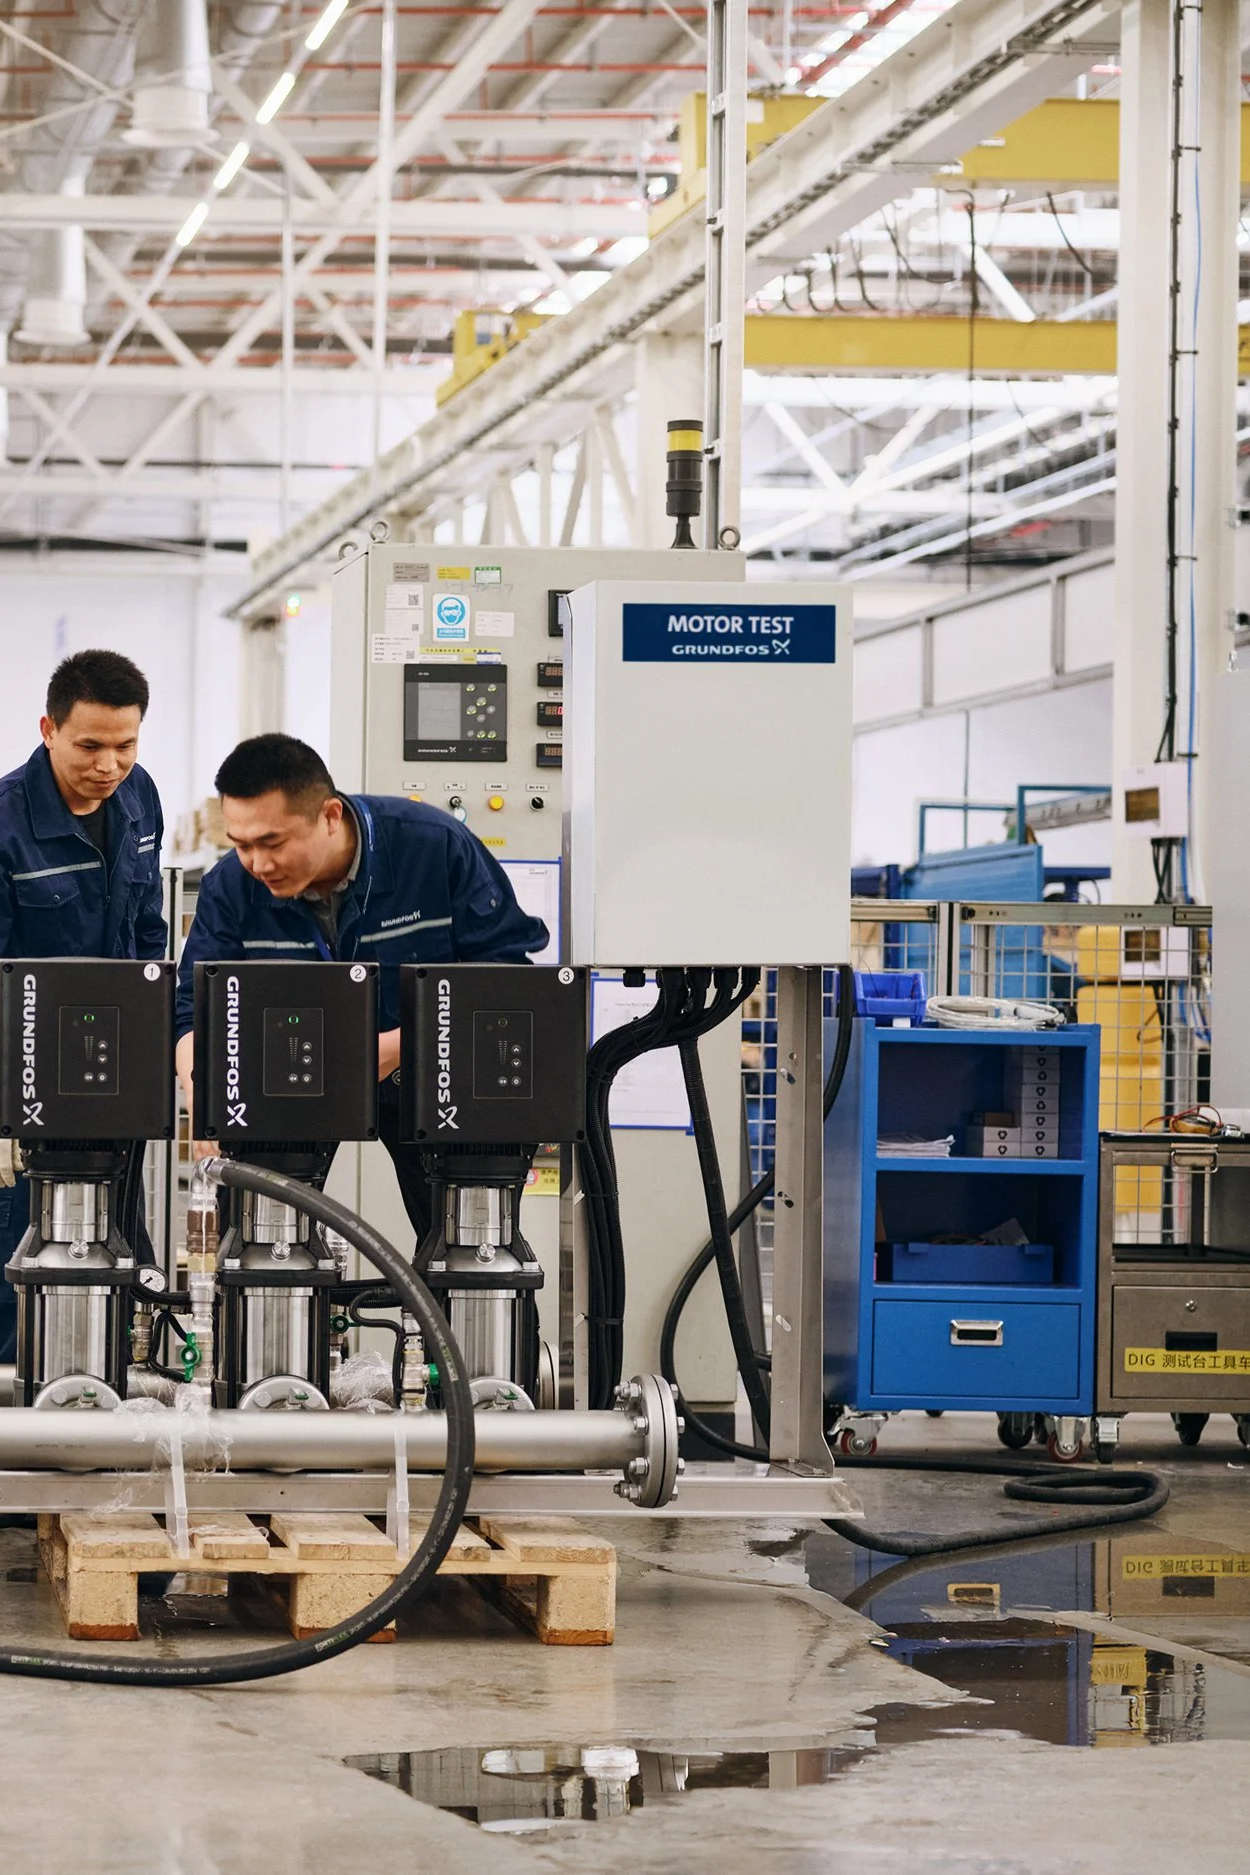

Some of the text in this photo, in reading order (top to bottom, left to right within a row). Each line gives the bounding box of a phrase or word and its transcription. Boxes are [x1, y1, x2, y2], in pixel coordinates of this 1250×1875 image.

[667, 615, 794, 635] MOTOR TEST
[672, 644, 769, 655] GRUNDFOS
[354, 968, 362, 979] 2
[562, 970, 571, 982] 3
[22, 974, 37, 1099] GRUNDFOS
[226, 976, 240, 1100] GRUNDFOS
[437, 979, 451, 1103] GRUNDFOS
[1128, 1353, 1250, 1369] DIG 测试台工具车
